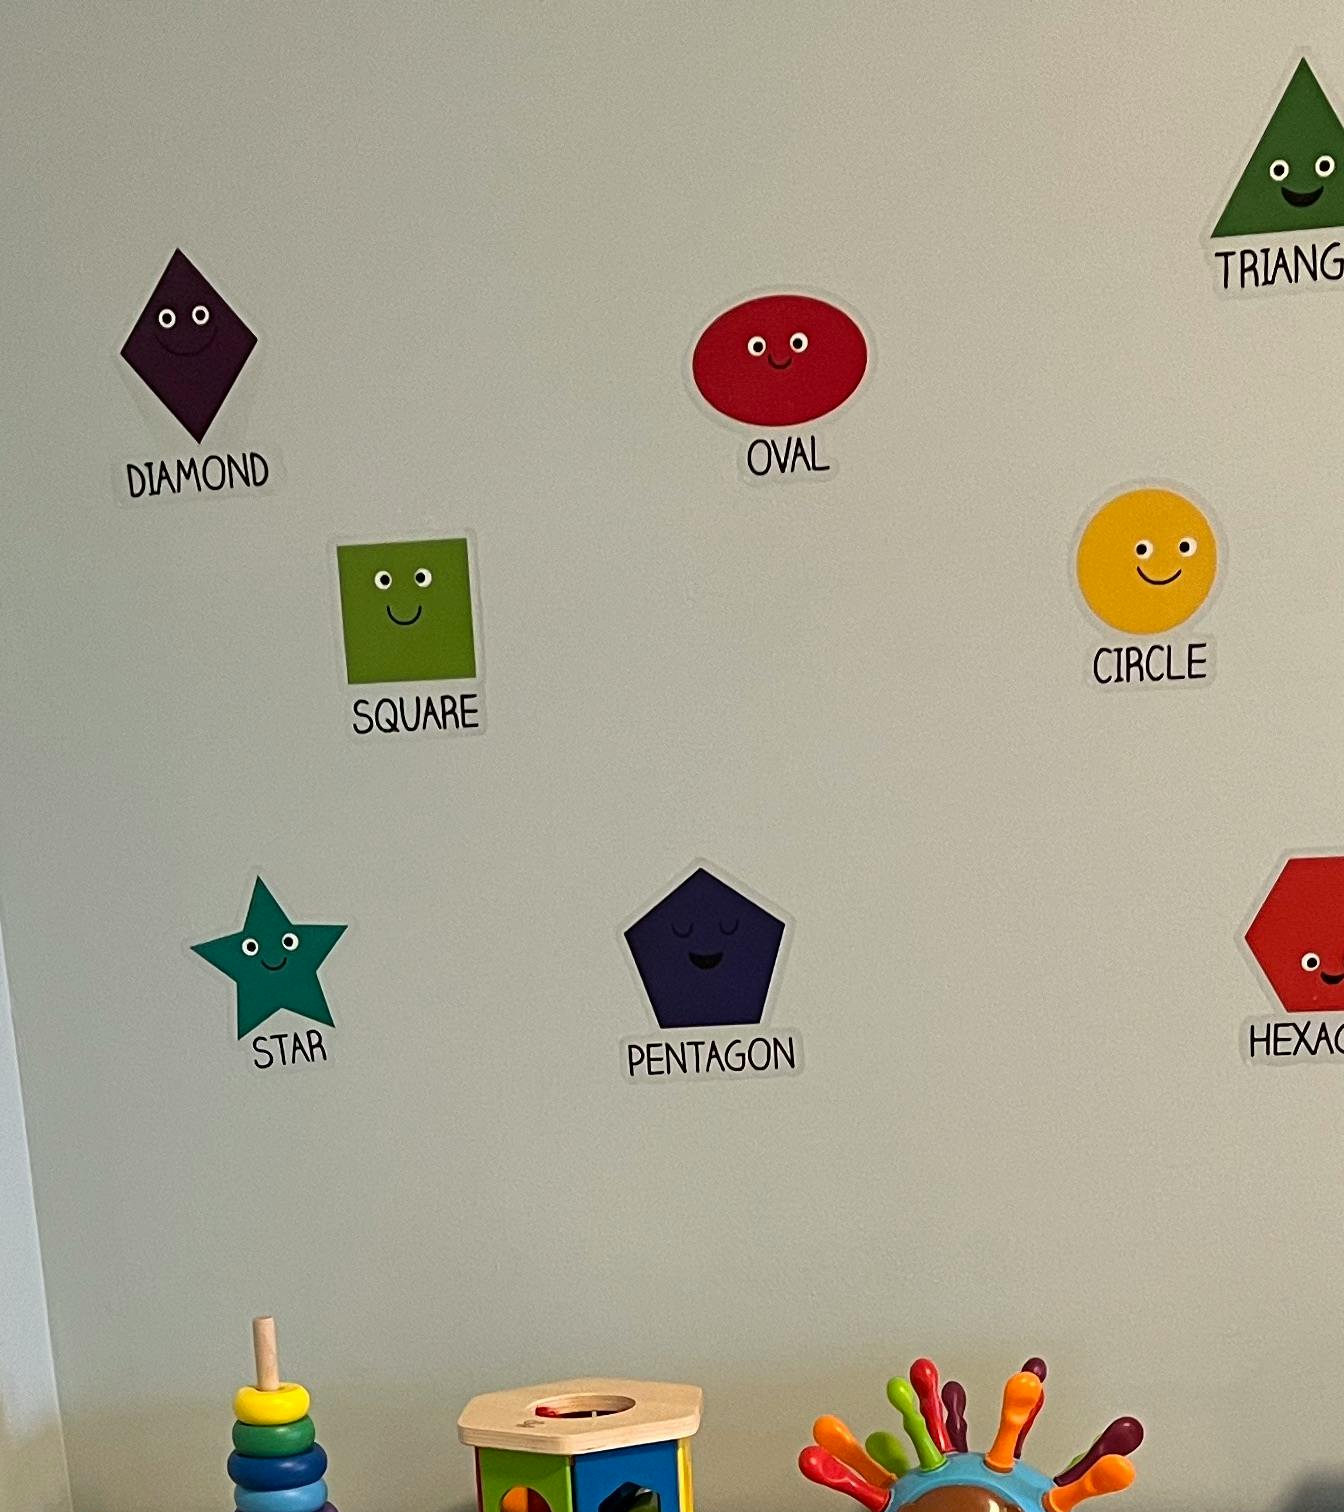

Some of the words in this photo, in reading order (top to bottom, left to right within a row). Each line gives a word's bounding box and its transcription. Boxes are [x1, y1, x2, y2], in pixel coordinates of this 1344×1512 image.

[126, 452, 269, 499] DIAMOND
[746, 435, 831, 477] OVAL
[1093, 643, 1207, 685] CIRCLE
[352, 693, 480, 735] SQUARE
[252, 1029, 328, 1070] STAR
[627, 1036, 796, 1077] PENTAGON
